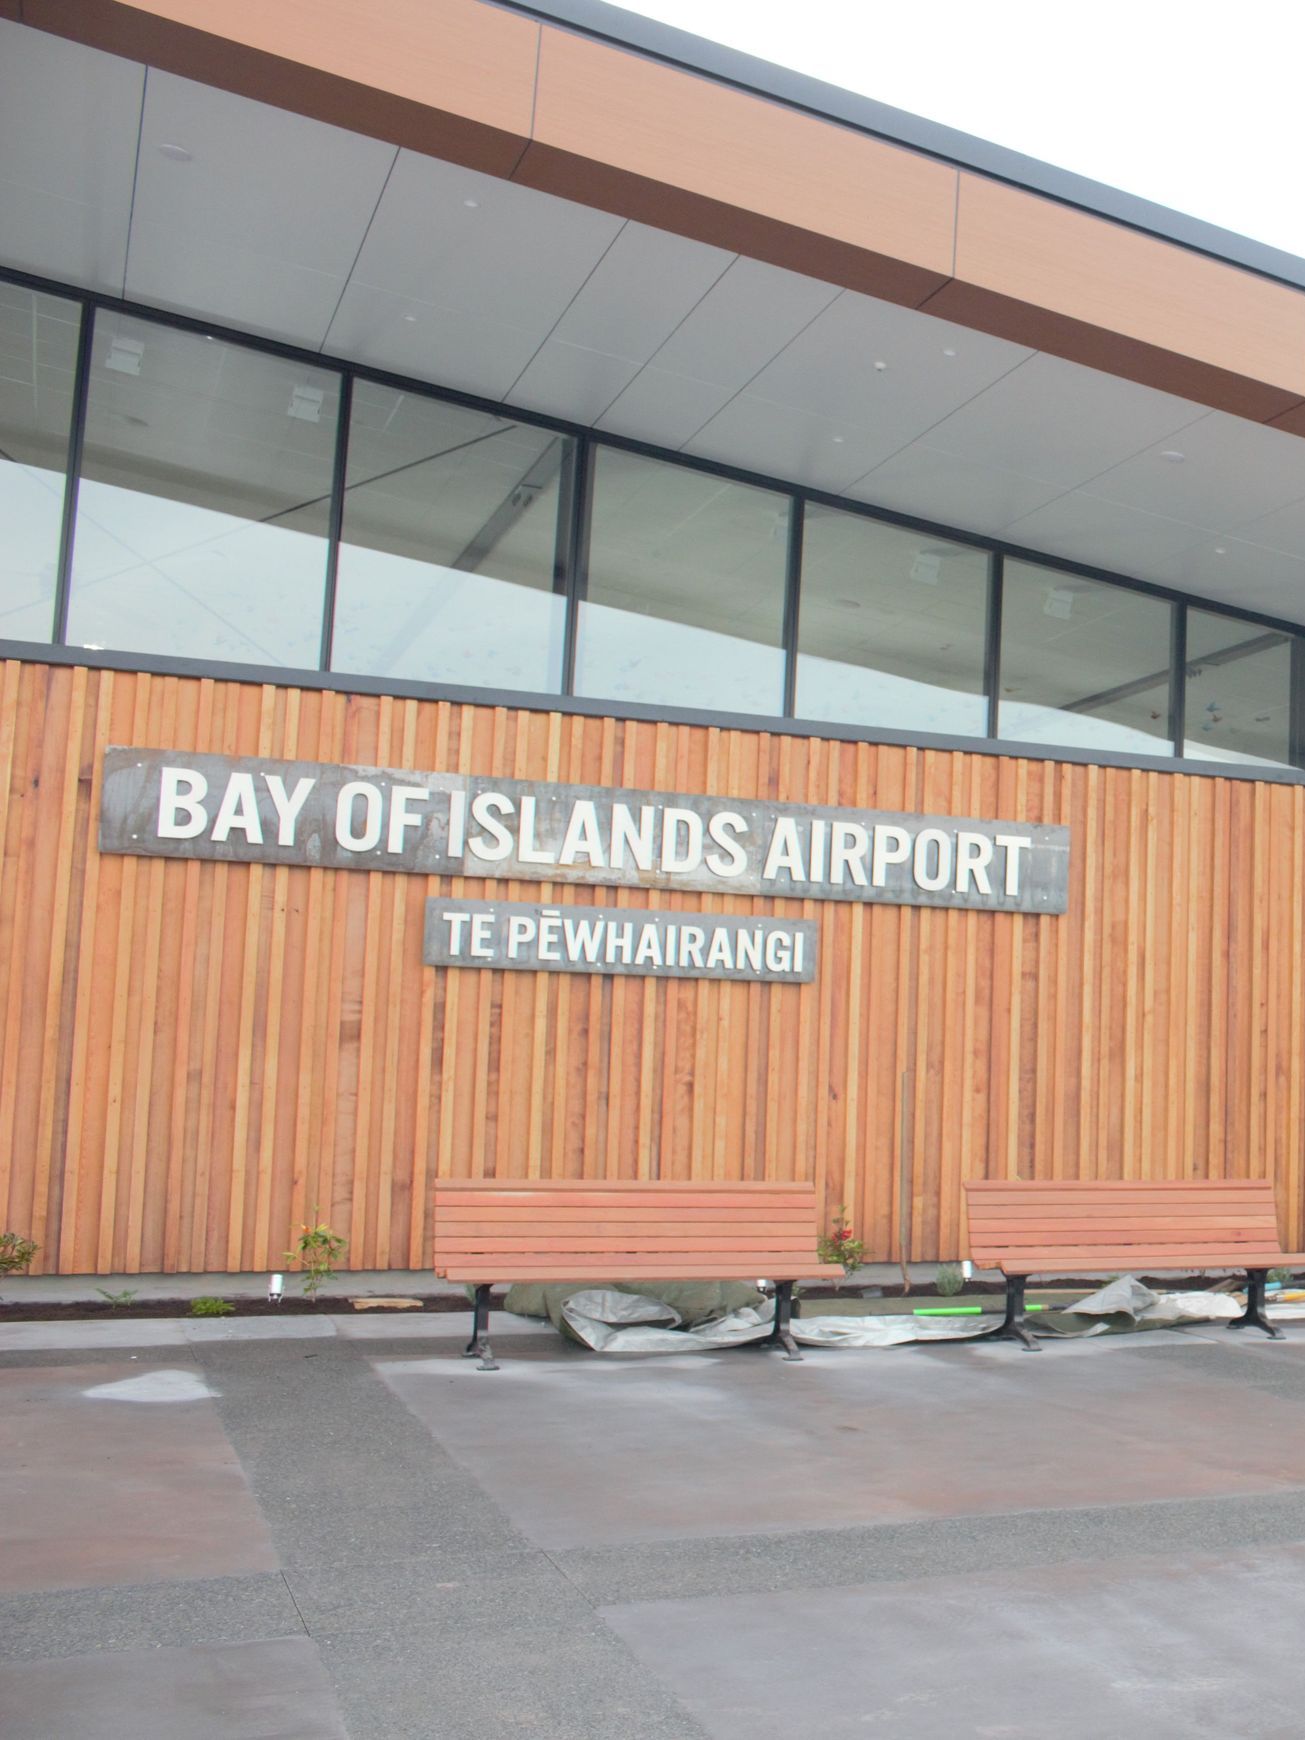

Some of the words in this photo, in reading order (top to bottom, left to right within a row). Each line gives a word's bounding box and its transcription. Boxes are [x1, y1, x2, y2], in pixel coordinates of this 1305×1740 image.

[156, 766, 316, 847] BAY
[334, 781, 430, 854] OF
[447, 789, 750, 878] ISLANDS
[762, 815, 1032, 896] AIRPORT
[442, 911, 496, 958] TE
[506, 909, 805, 973] PĒWHAIRANGI
